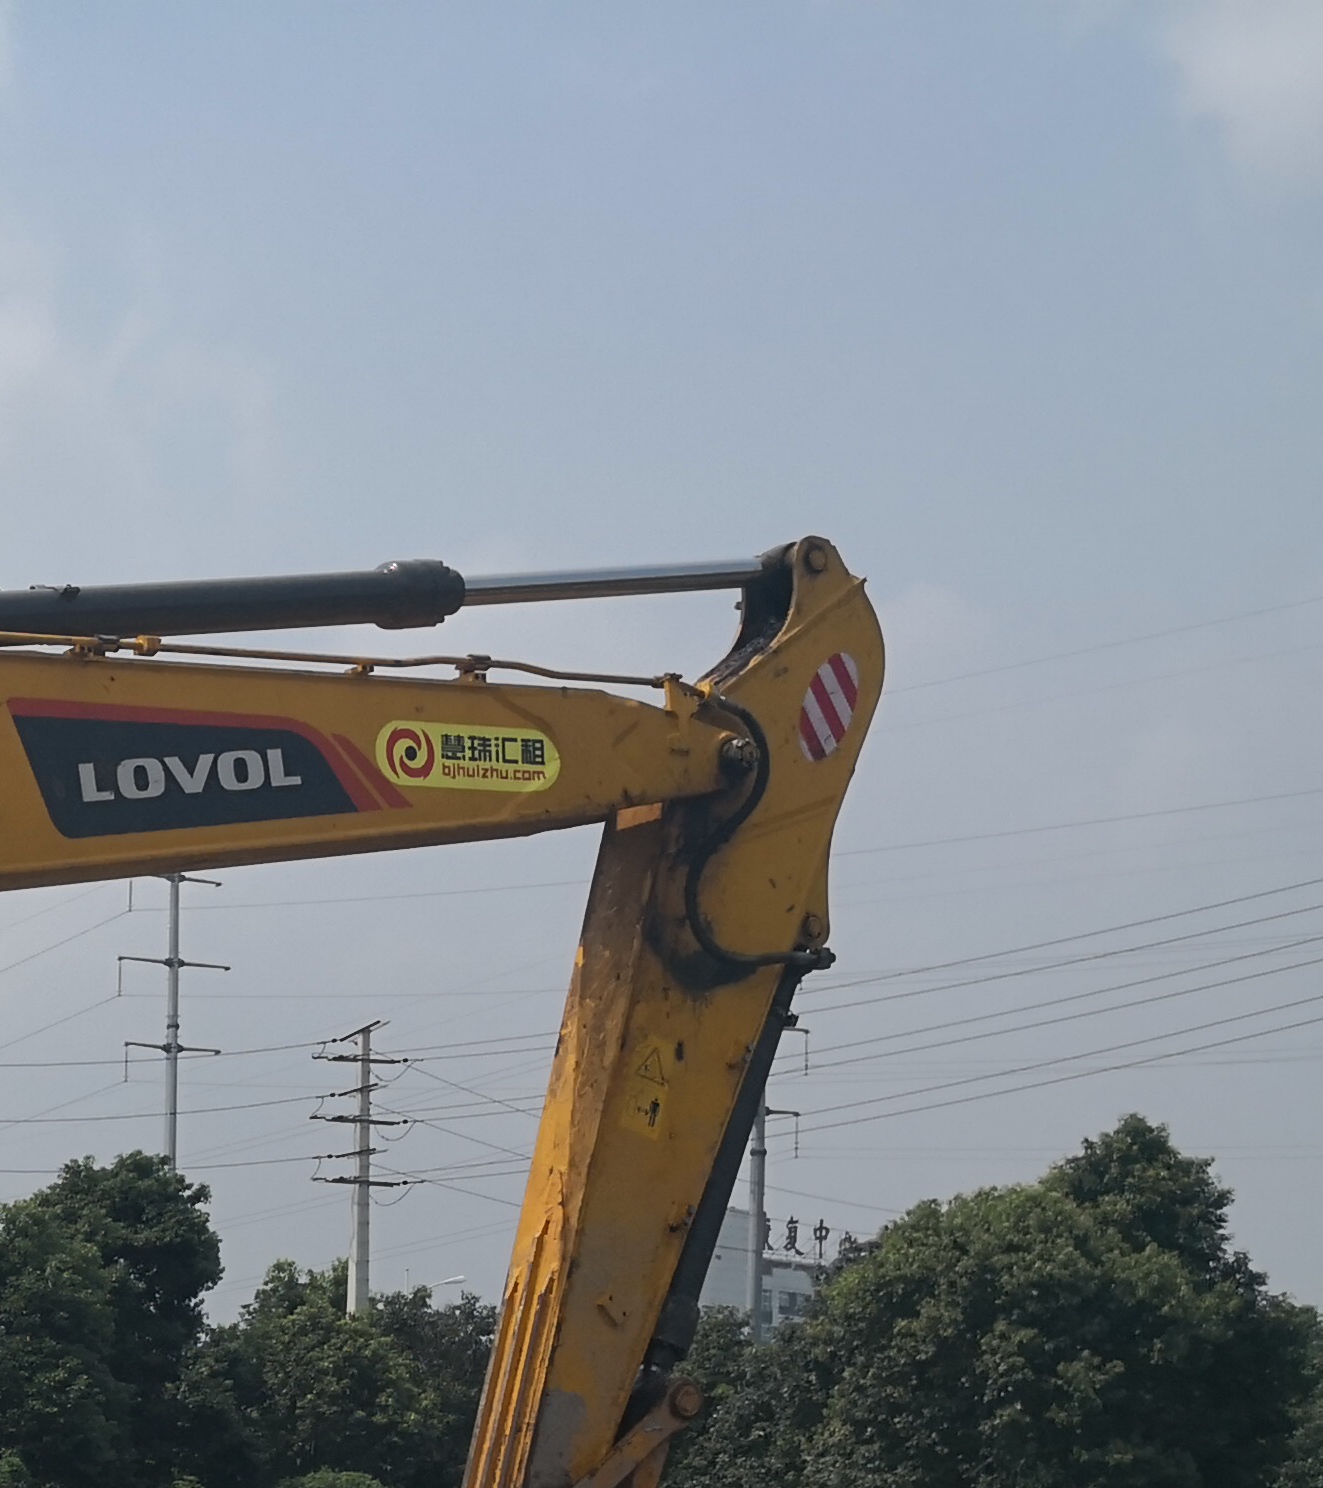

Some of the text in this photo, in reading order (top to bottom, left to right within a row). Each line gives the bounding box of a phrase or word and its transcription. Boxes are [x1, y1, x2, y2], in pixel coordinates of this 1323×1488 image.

[441, 734, 545, 766] 慧珠汇租
[78, 748, 302, 802] LOVOL
[442, 763, 546, 781] bjhuizhu.com
